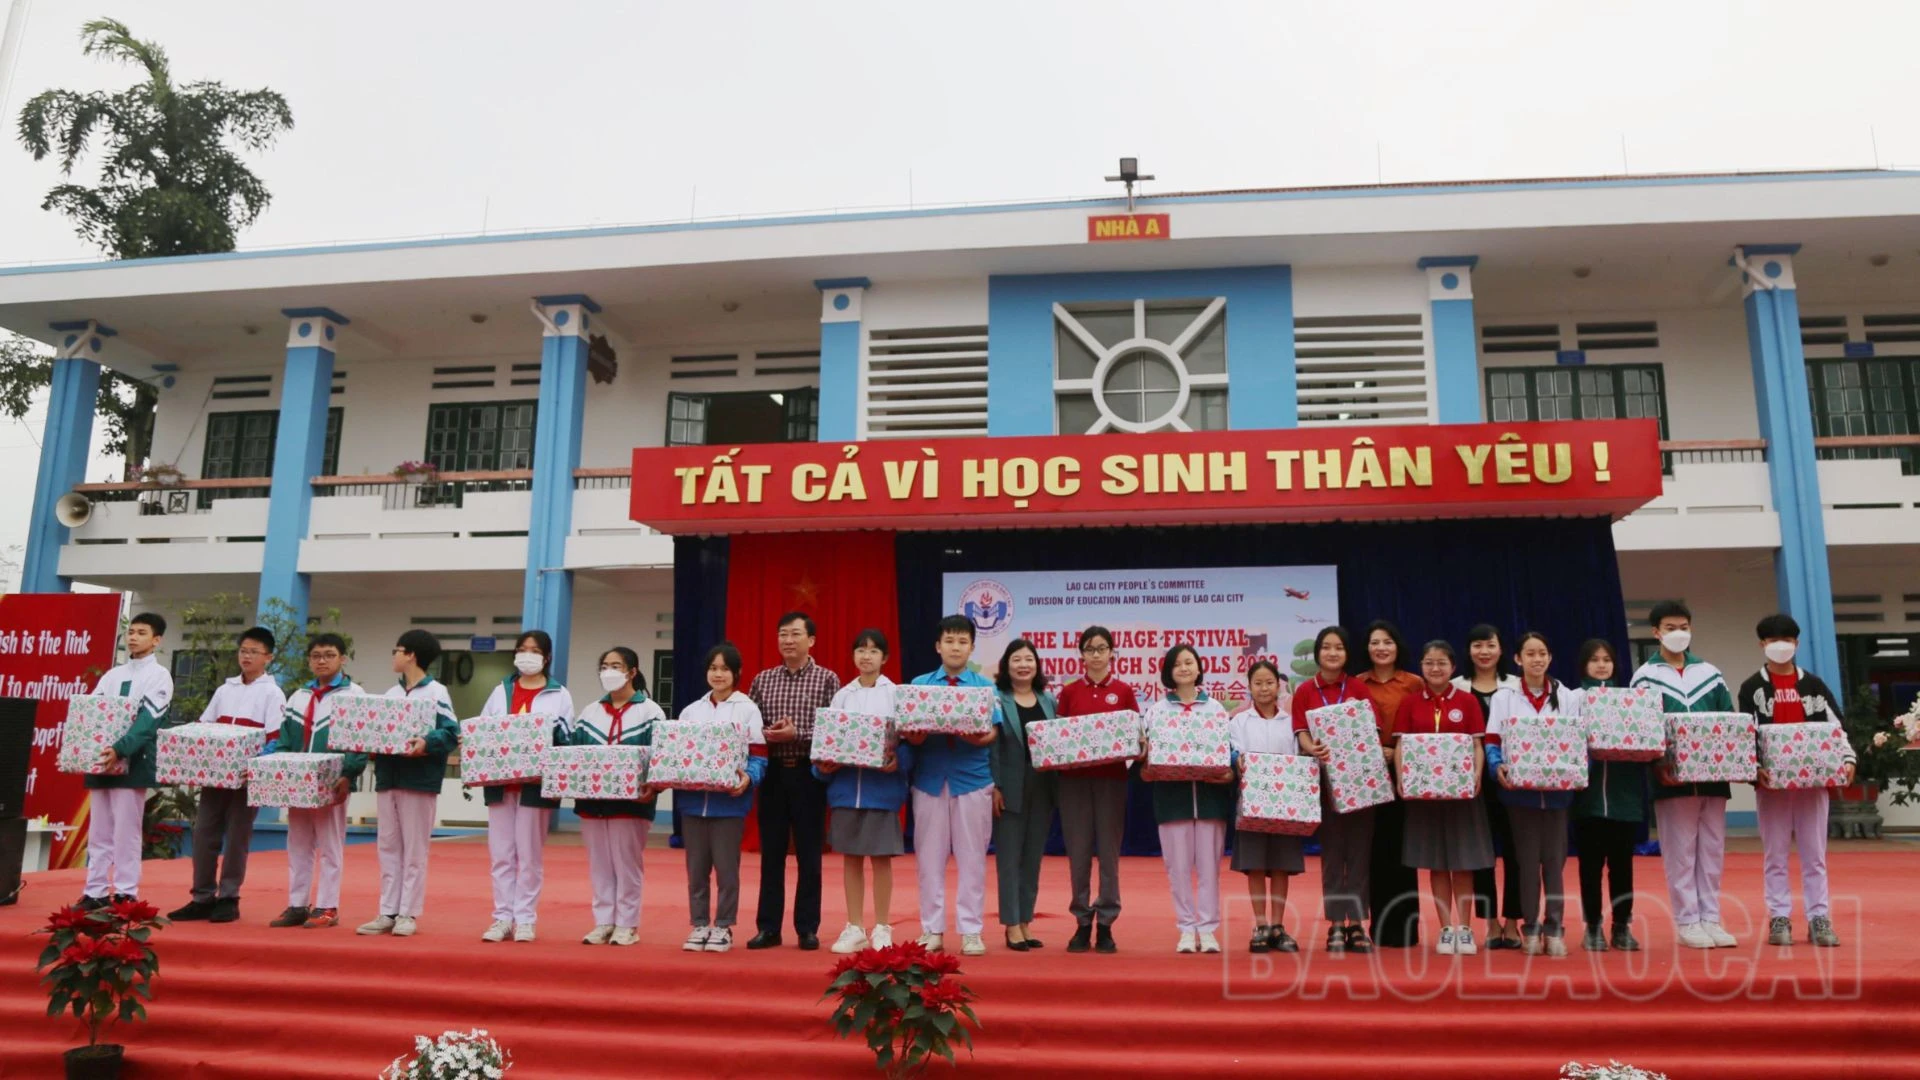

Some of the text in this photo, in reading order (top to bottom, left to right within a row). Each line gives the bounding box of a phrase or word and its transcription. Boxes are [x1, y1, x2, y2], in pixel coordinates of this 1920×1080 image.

[1095, 214, 1160, 237] NHÀ A
[674, 432, 1612, 508] TẤT CẢ VÌ HỌC SINH THÂN YÊU !
[1066, 582, 1081, 591] LAO
[1083, 581, 1097, 591] CAI
[1098, 581, 1116, 590] CITY
[1158, 579, 1205, 590] COMMITTEE
[1028, 593, 1244, 606] DIVISION OF EDUCATION AND TRAINING OF LAO CAI CITY
[21, 630, 35, 655] is
[39, 629, 62, 656] the
[65, 629, 91, 655] link
[1163, 628, 1249, 648] FESTIVAL
[8, 675, 22, 698] to
[25, 675, 88, 702] cultivate
